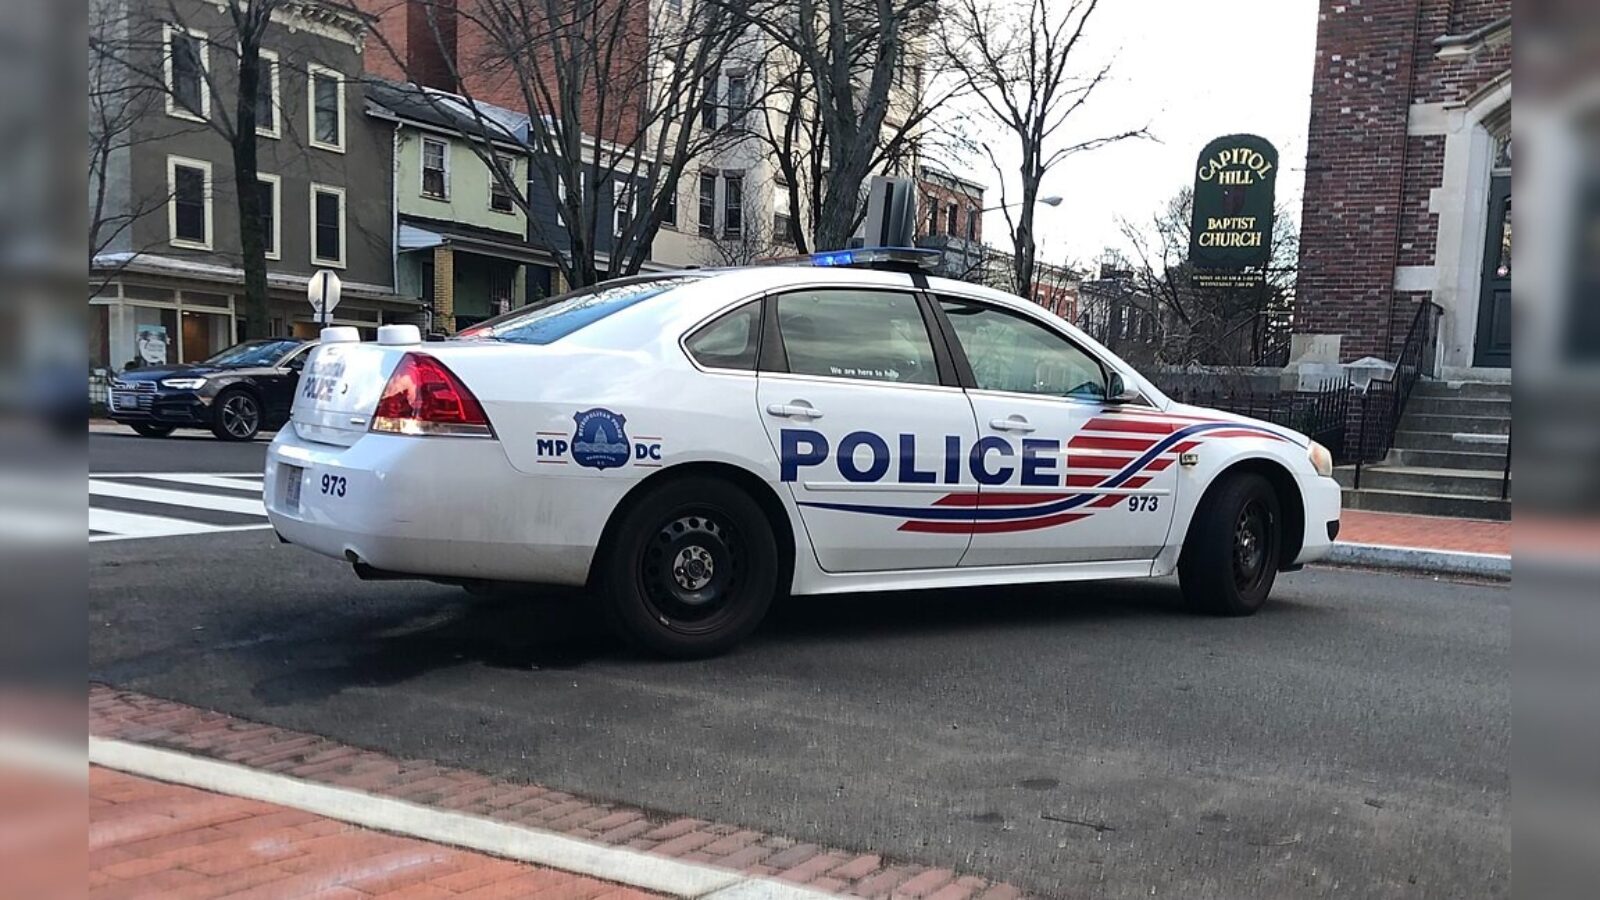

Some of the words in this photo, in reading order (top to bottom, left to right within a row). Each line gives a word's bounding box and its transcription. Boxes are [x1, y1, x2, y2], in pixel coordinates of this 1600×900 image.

[1199, 147, 1273, 181] CAPITOL
[1219, 170, 1254, 185] HILL
[1207, 216, 1257, 230] BAPTIST
[1198, 231, 1262, 247] CHURCH
[830, 366, 842, 375] We
[857, 368, 873, 376] here
[537, 439, 568, 456] MP
[635, 444, 662, 460] DC
[780, 428, 1060, 487] POLICE
[321, 473, 347, 498] 973
[1128, 496, 1158, 512] 973
